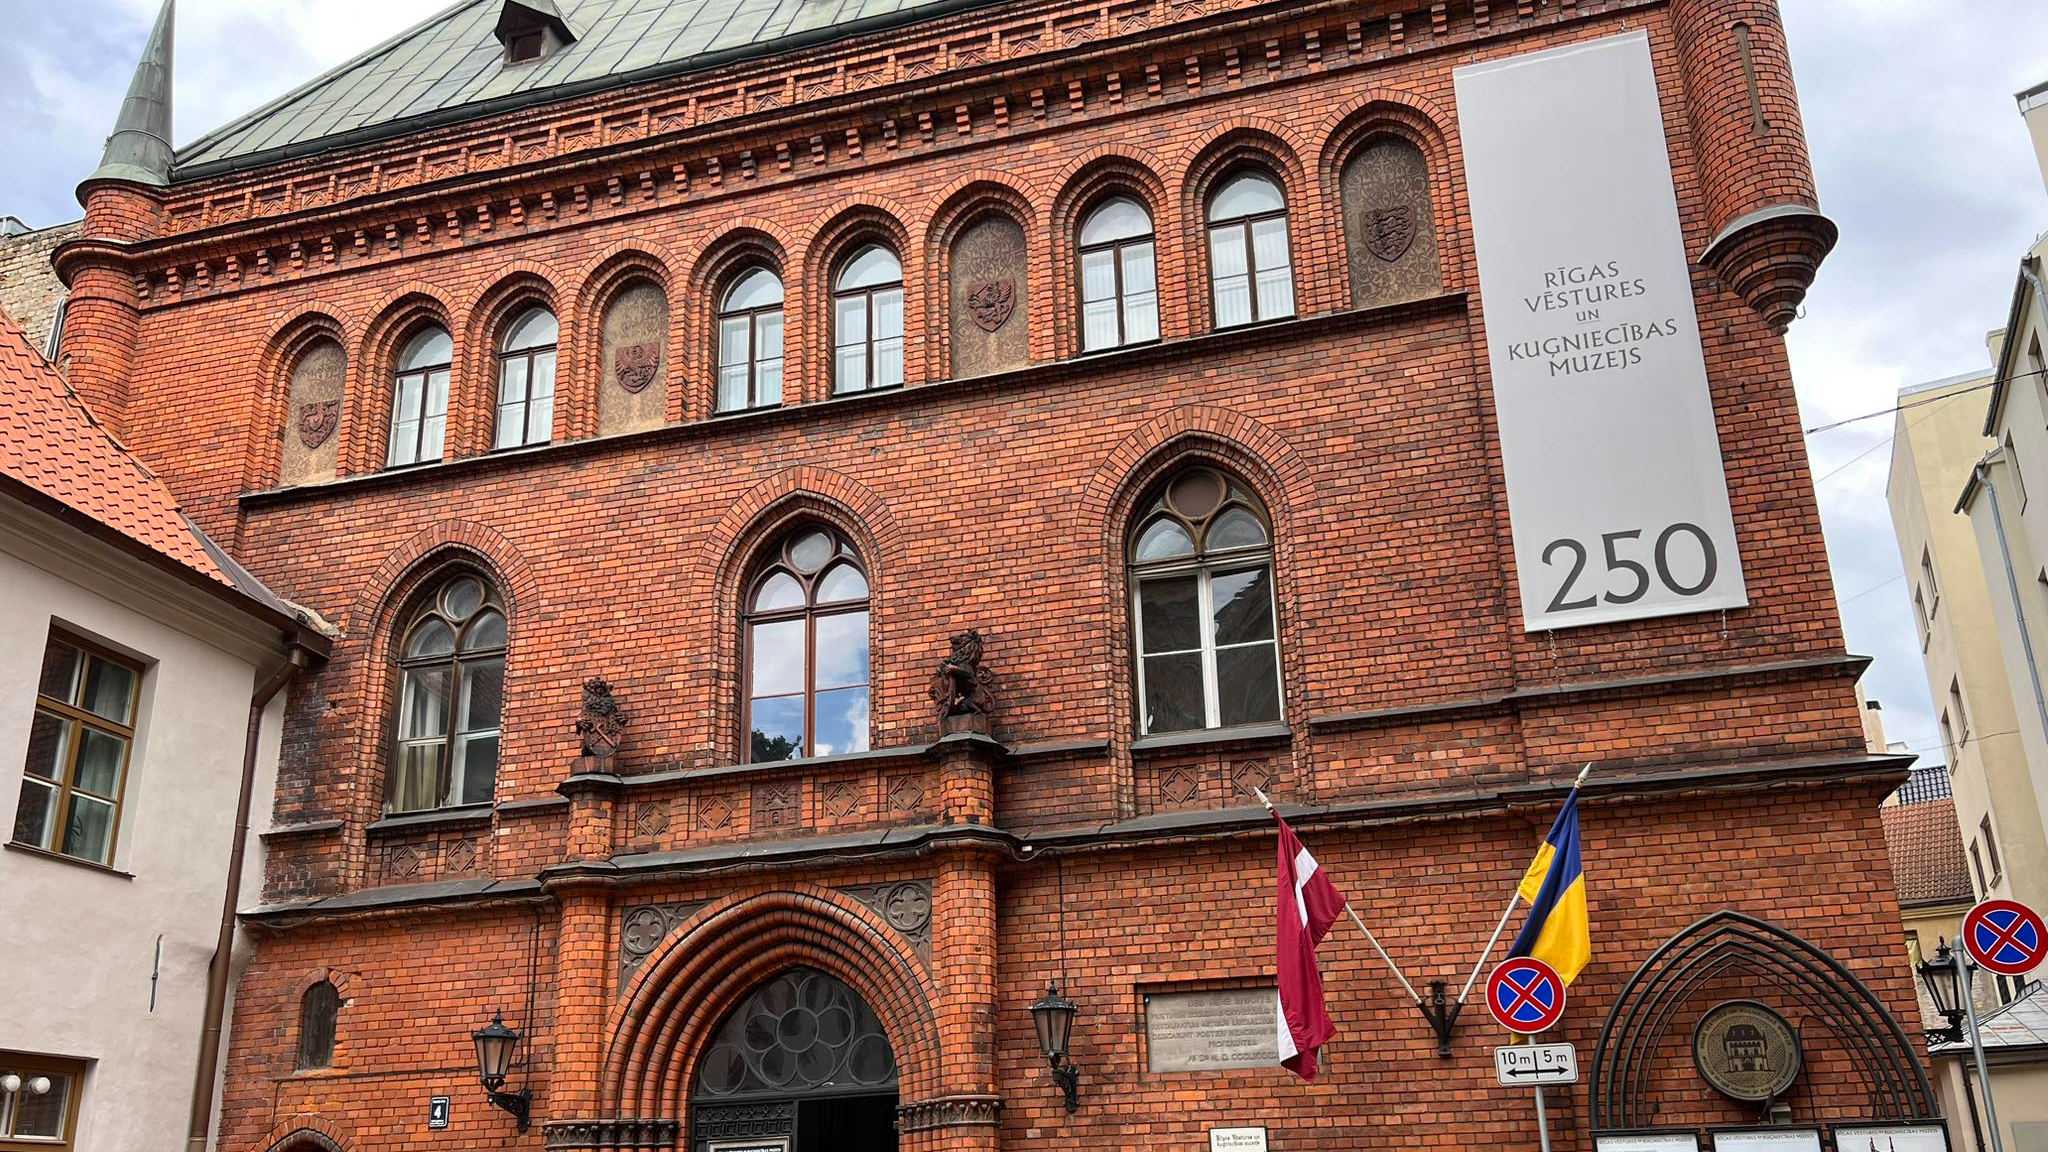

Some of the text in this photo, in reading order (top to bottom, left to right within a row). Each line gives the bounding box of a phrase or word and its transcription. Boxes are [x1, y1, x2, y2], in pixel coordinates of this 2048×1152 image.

[1544, 261, 1619, 288] RĪGAS
[1524, 278, 1646, 313] VĒSTURES
[1576, 308, 1600, 322] UN
[1508, 318, 1678, 361] KUĢNIECĪBAS
[1548, 347, 1642, 377] MUZEJS
[1541, 522, 1718, 613] 250
[1501, 1051, 1531, 1065] 10 m
[1543, 1050, 1568, 1063] 5 m
[434, 1105, 441, 1118] 4
